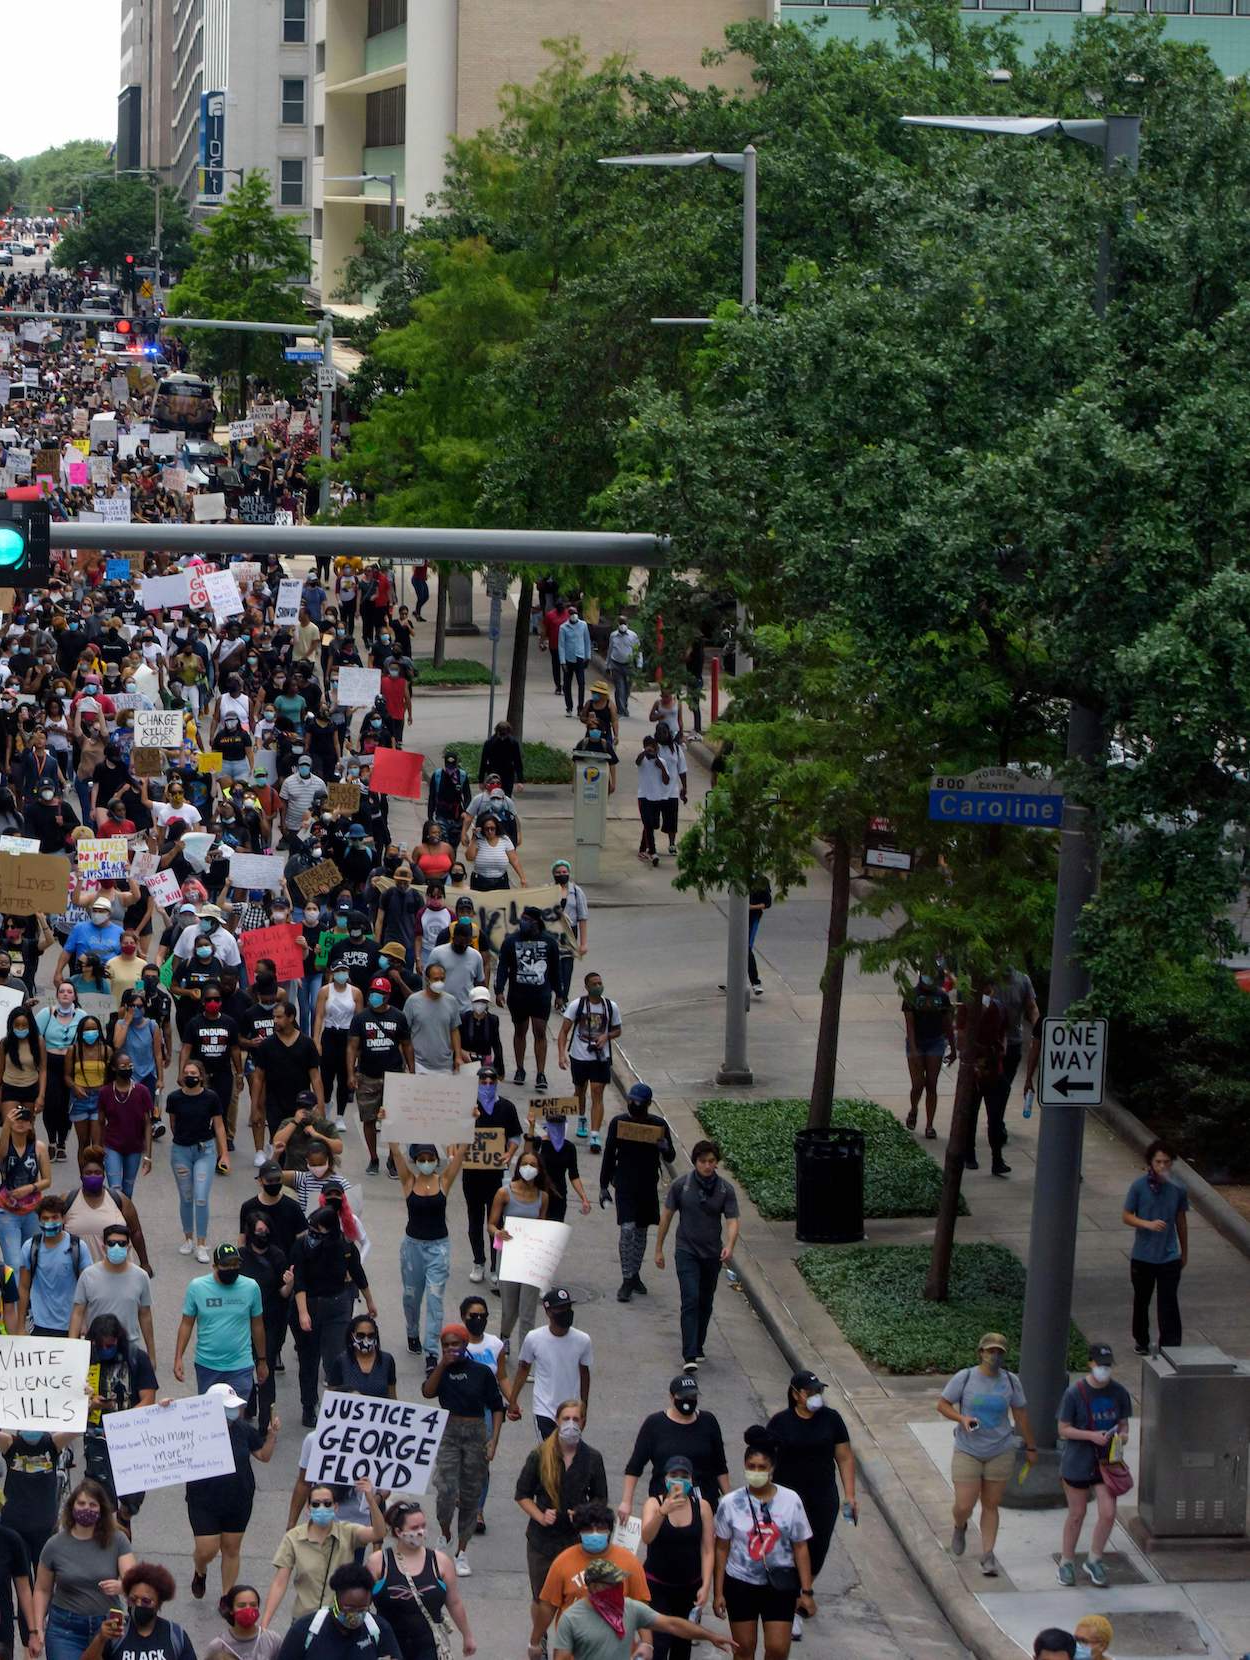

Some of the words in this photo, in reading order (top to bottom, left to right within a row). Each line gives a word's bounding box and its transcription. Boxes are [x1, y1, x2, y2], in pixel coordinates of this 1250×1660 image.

[142, 727, 175, 736] KILLER
[975, 769, 1021, 782] HOUSTON
[937, 778, 965, 790] 800
[979, 782, 1015, 790] CENTER
[940, 795, 1054, 819] Caroline
[343, 951, 368, 959] SUPER
[343, 957, 368, 967] LACK
[254, 1020, 274, 1028] ENOU
[1053, 1026, 1097, 1046] ONE
[1050, 1051, 1097, 1070] WAY
[0, 1375, 73, 1391] SILENCE
[3, 1397, 75, 1422] KILLS
[324, 1399, 416, 1428] JUSTICE
[421, 1410, 439, 1433] 4
[141, 1430, 165, 1447] How
[167, 1430, 194, 1441] many
[319, 1425, 436, 1465] GEORGE
[319, 1455, 412, 1488] FLOYD
